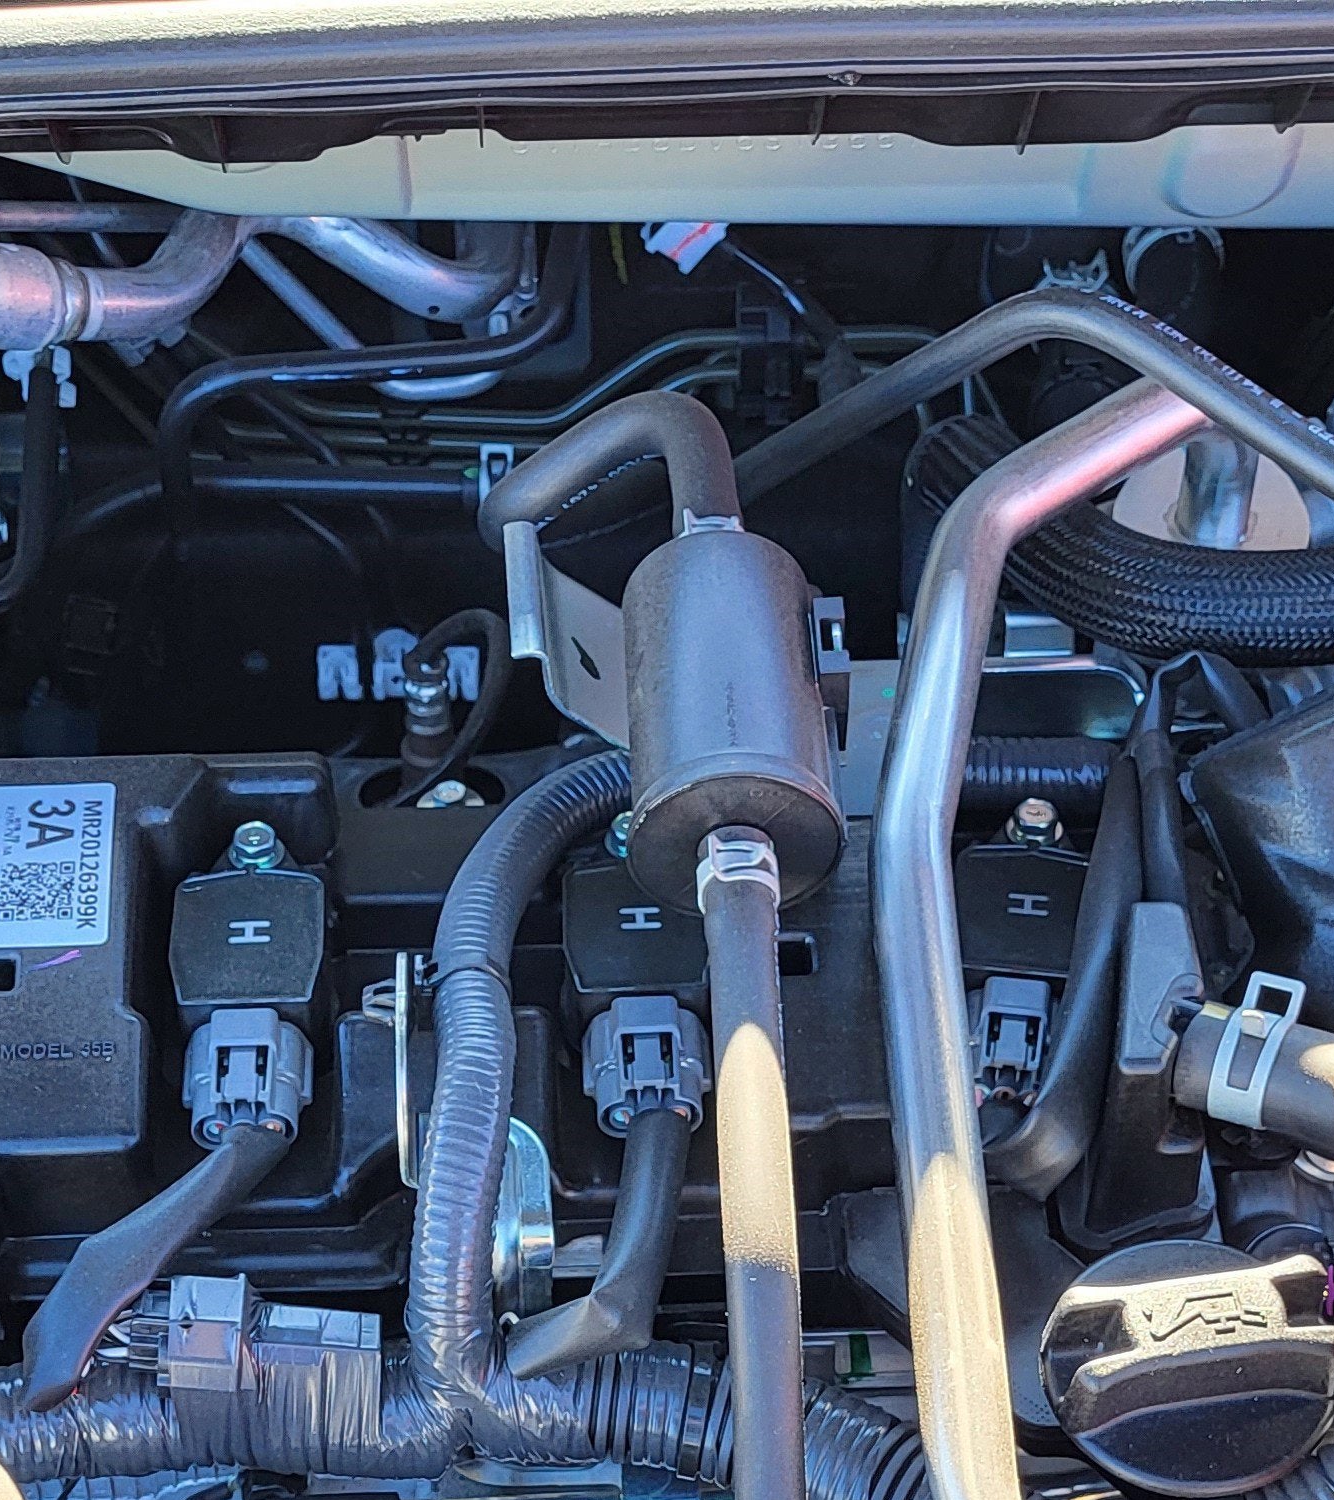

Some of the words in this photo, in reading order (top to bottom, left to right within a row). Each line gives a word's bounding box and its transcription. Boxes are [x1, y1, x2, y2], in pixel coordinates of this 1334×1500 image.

[24, 799, 77, 850] 3A
[76, 800, 103, 930] MR20126399K
[0, 1043, 73, 1060] MODEL
[79, 1041, 116, 1058] 35B
